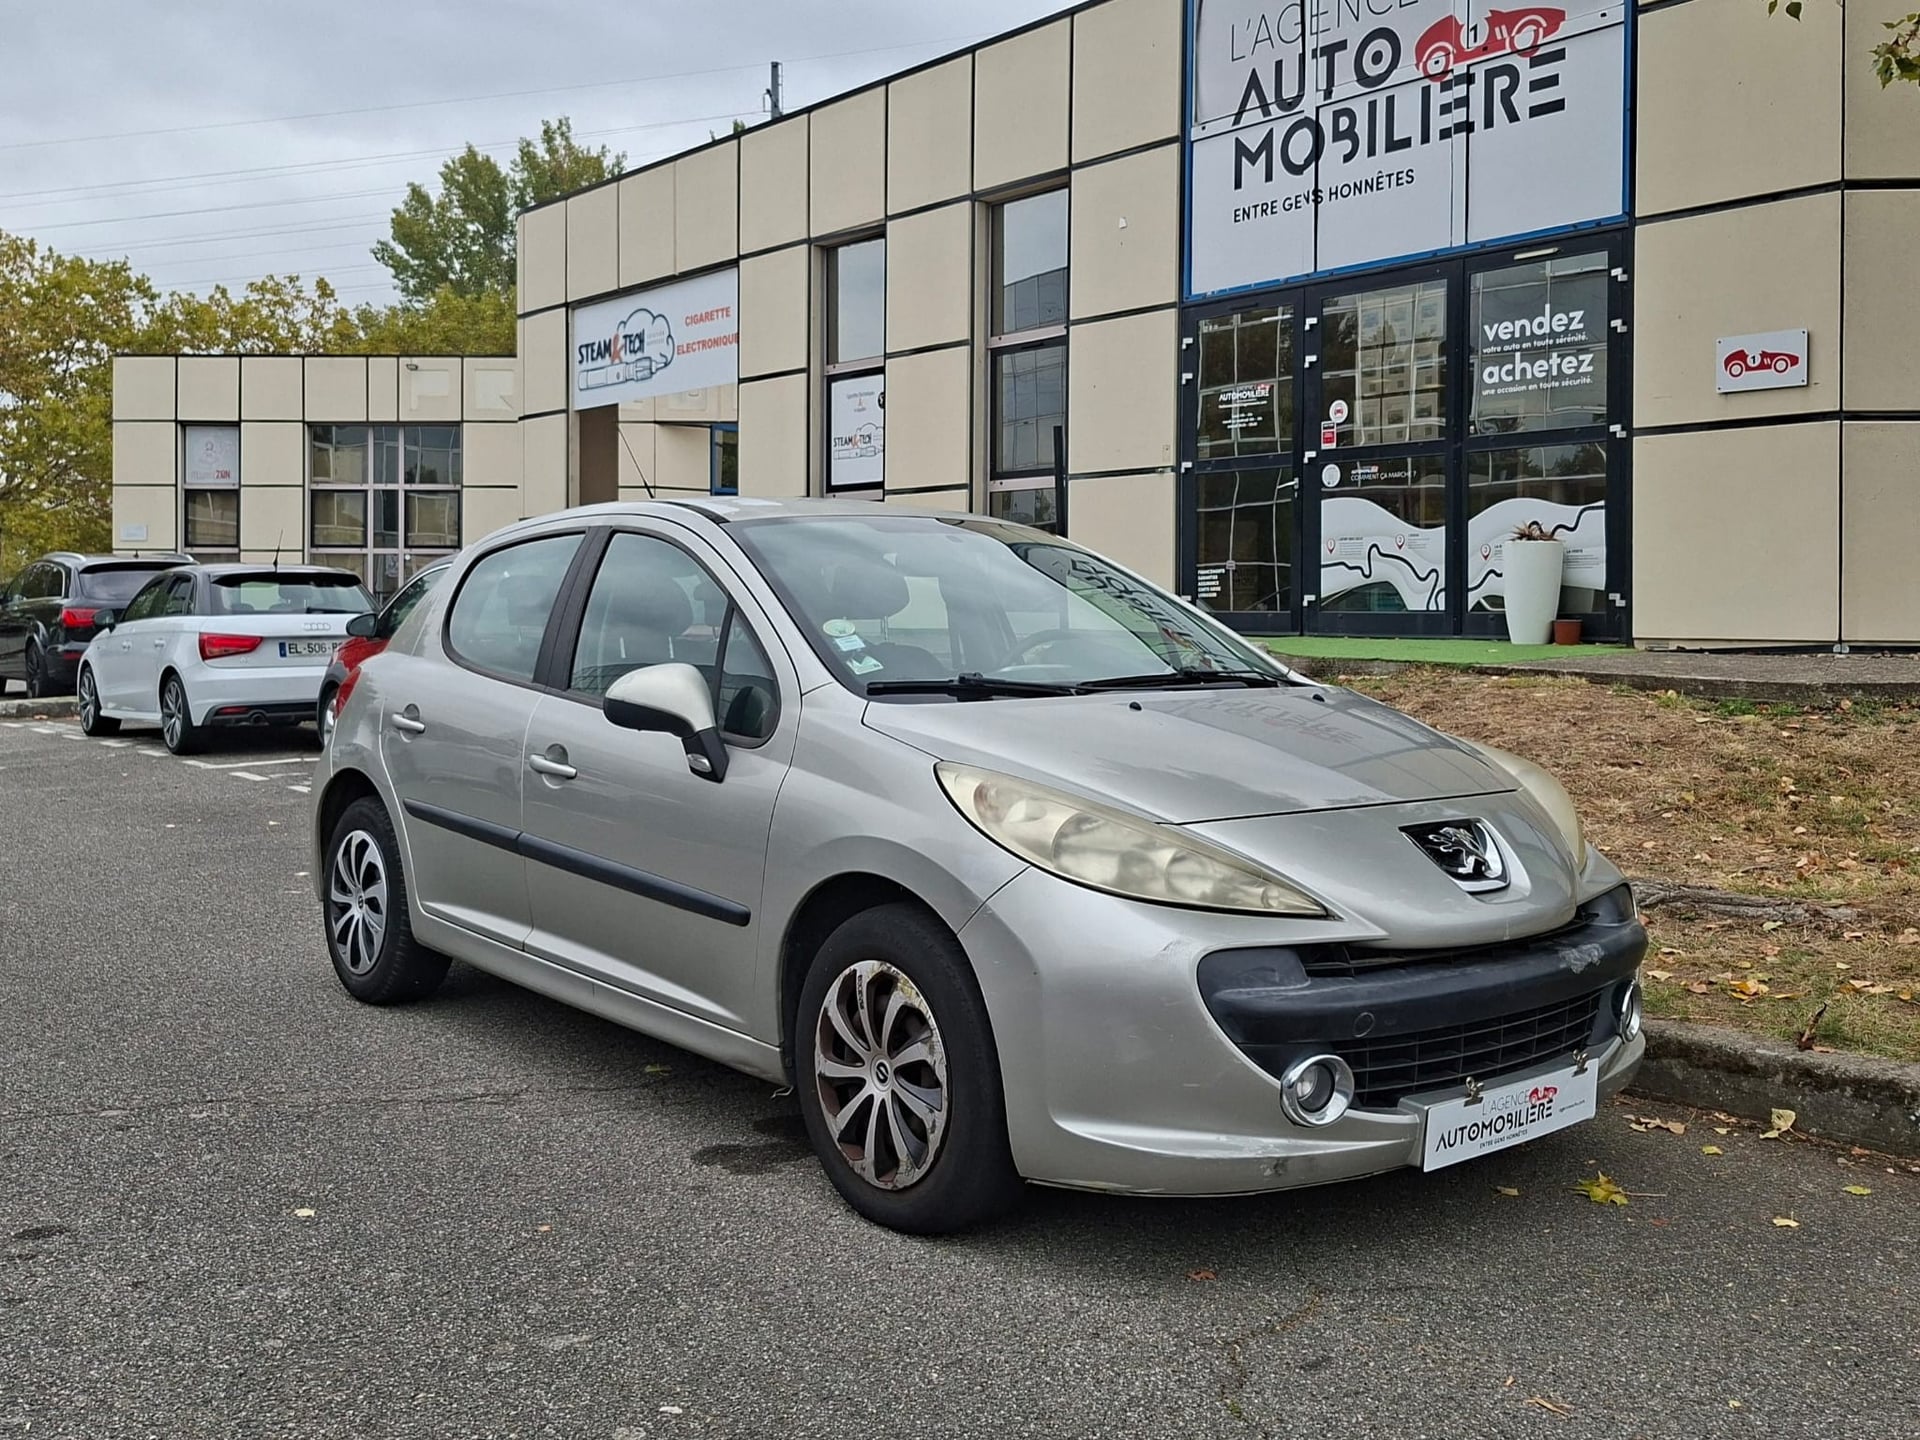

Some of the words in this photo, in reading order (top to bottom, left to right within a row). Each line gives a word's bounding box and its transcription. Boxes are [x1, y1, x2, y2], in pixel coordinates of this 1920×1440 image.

[1232, 0, 1419, 62] L'AGEN
[1231, 27, 1402, 127] AUTO
[1233, 200, 1278, 223] ENTRE
[1328, 169, 1415, 202] HONNÊTES
[684, 306, 731, 327] CIGARETTE
[1483, 304, 1585, 342] vendez
[1482, 345, 1501, 354] votre
[1503, 342, 1520, 351] auto
[1533, 339, 1554, 347] toute
[1482, 352, 1594, 384] achetez
[1482, 388, 1496, 396] une
[1497, 384, 1527, 394] occasion
[1539, 380, 1560, 389] toute
[1482, 1088, 1530, 1116] L'AGENCE
